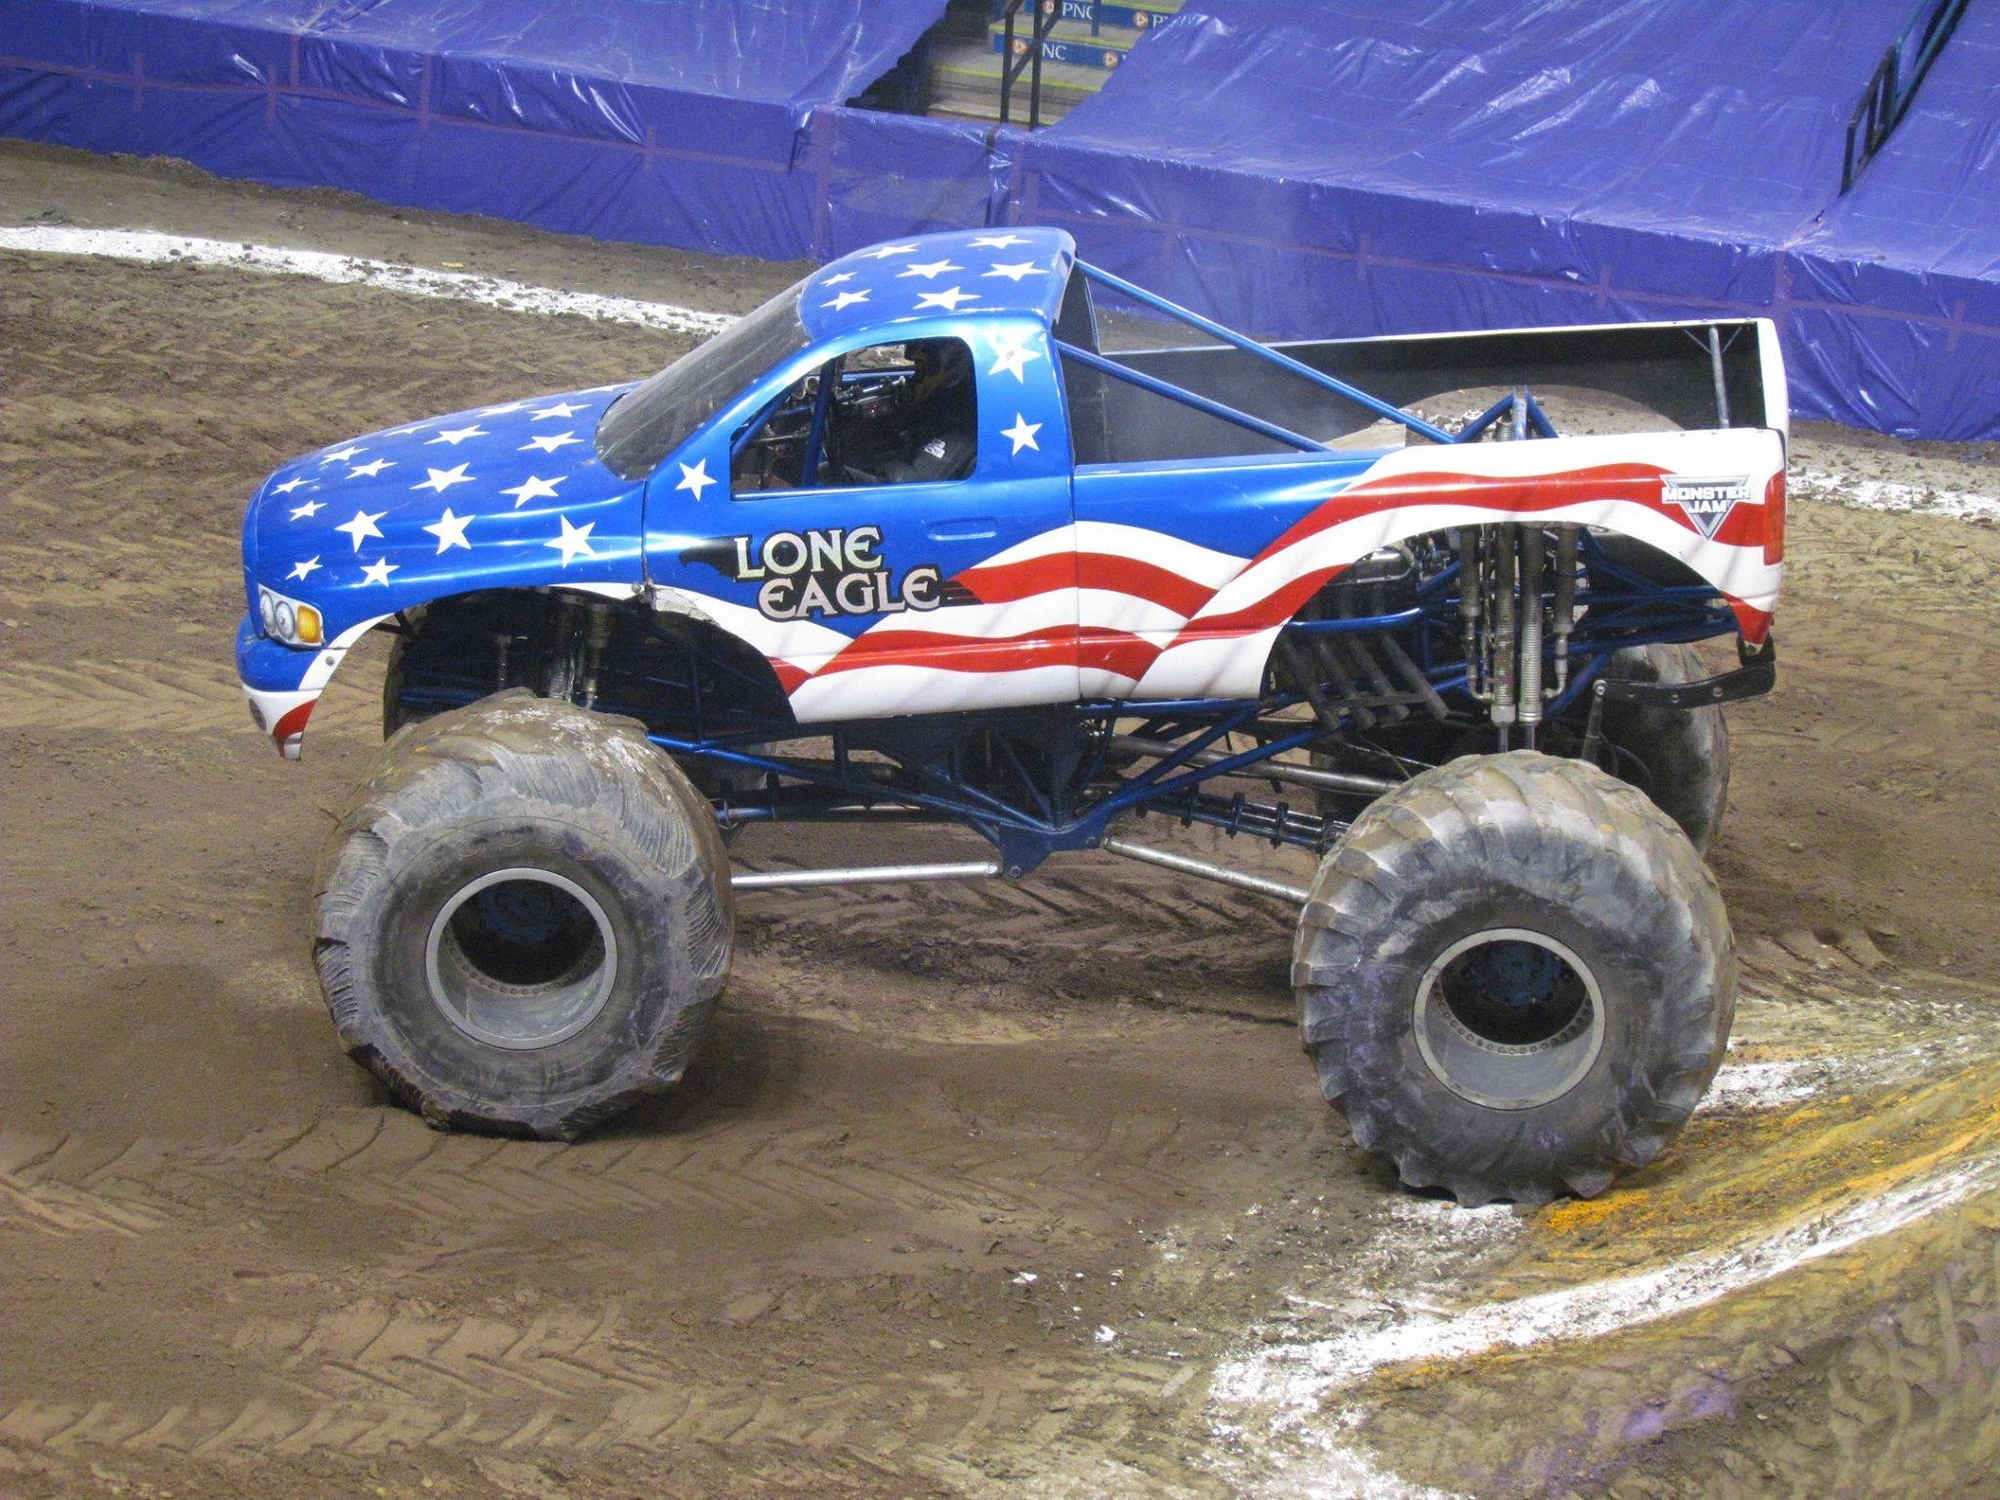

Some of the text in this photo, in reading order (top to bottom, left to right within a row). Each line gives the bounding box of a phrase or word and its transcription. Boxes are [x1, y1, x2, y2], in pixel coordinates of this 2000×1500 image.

[1062, 2, 1094, 20] PNC
[1042, 42, 1067, 60] NC
[1663, 486, 1751, 501] MONSTER
[1688, 500, 1728, 514] JAM
[733, 526, 882, 579] LONE
[758, 568, 941, 619] EAGLE
